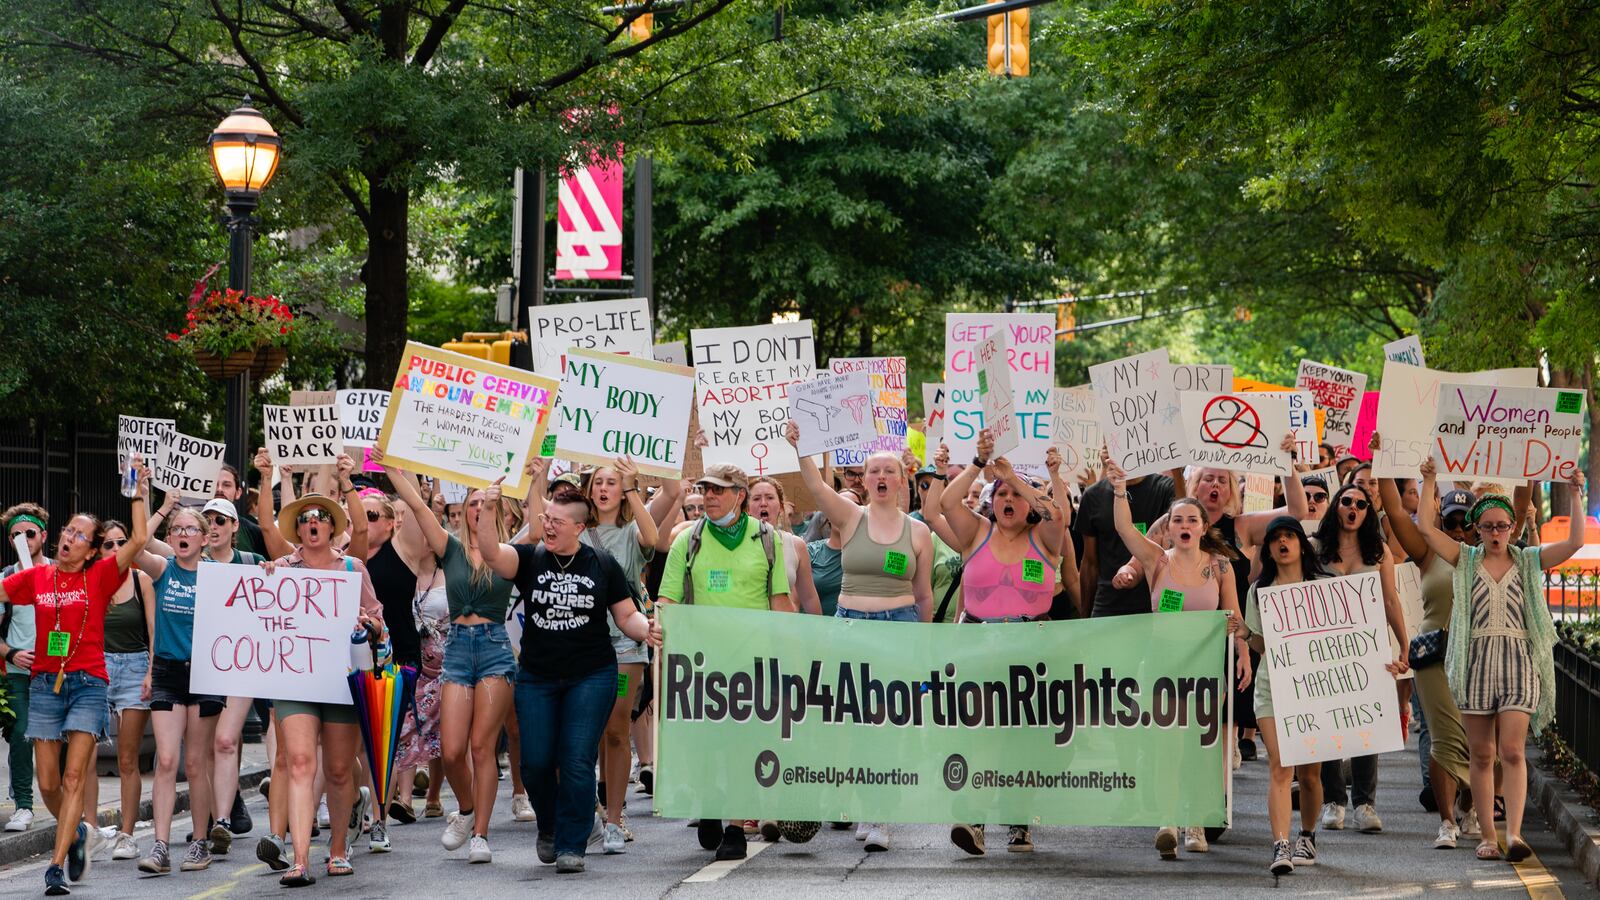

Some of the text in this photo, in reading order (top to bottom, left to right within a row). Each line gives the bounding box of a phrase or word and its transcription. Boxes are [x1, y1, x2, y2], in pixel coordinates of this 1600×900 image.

[538, 310, 645, 337] PRO-LIFE
[952, 322, 1053, 345] GET YOUR
[604, 335, 615, 347] A
[696, 343, 722, 365] I
[733, 334, 812, 364] DON'T
[980, 340, 998, 364] HER
[886, 358, 906, 374] KIDS
[952, 349, 1049, 374] CHRCH
[408, 355, 477, 385] PUBLIC
[483, 376, 551, 406] CERVIX
[566, 360, 606, 388] MY
[698, 368, 776, 386] REGRET
[789, 364, 811, 378] MY
[884, 374, 906, 390] KILL
[1114, 360, 1140, 393] MY
[1302, 364, 1353, 384] KEEP YOUR
[346, 392, 390, 407] GIVE
[395, 373, 549, 424] ANNOUNCEMENT
[606, 385, 664, 418] BODY
[702, 379, 804, 406] ABORTI
[1025, 388, 1049, 405] MY
[1289, 395, 1303, 408] IS
[1312, 389, 1354, 410] ASCIST
[266, 407, 338, 423] WE WILL
[358, 409, 380, 423] US
[1109, 390, 1157, 426] BODY
[1326, 407, 1349, 420] OFF
[1457, 388, 1549, 423] Women
[119, 418, 174, 436] PROTECT
[414, 400, 521, 436] THE HARDEST DECISION
[560, 406, 599, 433] MY
[713, 410, 740, 428] MY
[954, 410, 1052, 440] STTE
[1324, 418, 1352, 435] ODIES
[268, 424, 337, 440] NOT GO
[416, 431, 461, 449] ISN'T
[422, 418, 504, 444] A WOMAN MAKES
[714, 429, 742, 447] MY
[1126, 421, 1150, 449] MY
[1439, 421, 1465, 436] and
[1477, 423, 1537, 439] pregnant
[160, 428, 226, 461] MY BODY
[278, 442, 336, 458] BACK
[602, 430, 678, 464] CHOICE
[167, 451, 190, 471] MY
[1122, 442, 1182, 472] CHOICE
[1438, 437, 1576, 480] Will Die
[154, 466, 214, 494] CHOICE
[537, 570, 557, 584] OUR
[550, 581, 578, 593] OUR
[225, 576, 347, 618] ABORT
[531, 589, 595, 609] FUTURES
[258, 616, 299, 632] THE
[531, 611, 590, 631] ABORTIONS
[546, 607, 574, 619] OUR
[211, 634, 330, 674] COURT
[1270, 628, 1379, 669] WE ALREADY
[1293, 661, 1369, 700] MARCHED
[666, 650, 1219, 748] RiseUp4AbortionRights.org
[1284, 713, 1320, 737] FOR
[782, 766, 919, 787] @RiseUp4Abortion
[971, 769, 1136, 791] @Rise4AbortionRights
